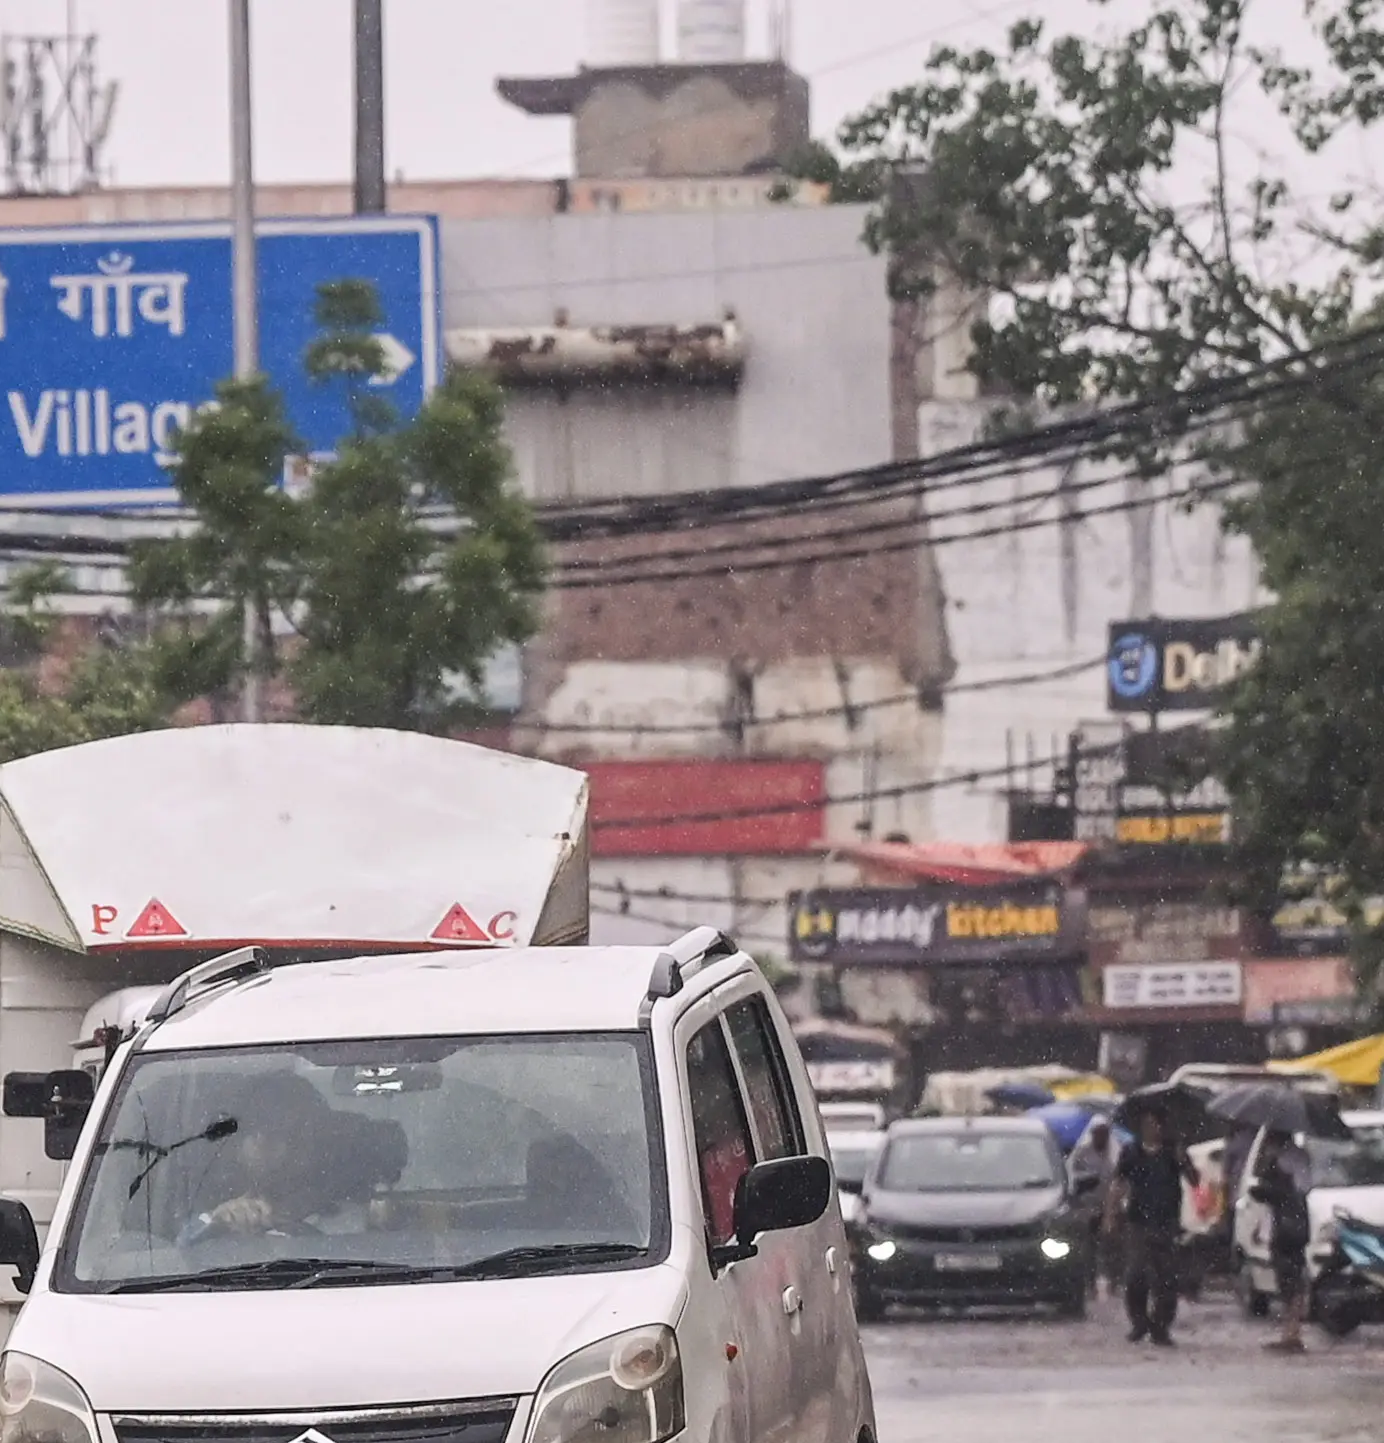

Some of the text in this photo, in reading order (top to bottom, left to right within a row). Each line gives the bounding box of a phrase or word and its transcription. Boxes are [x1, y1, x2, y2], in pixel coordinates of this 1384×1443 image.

[50, 251, 189, 337] गाँव
[9, 387, 220, 467] Villag
[91, 904, 119, 934] P
[488, 910, 520, 940] C
